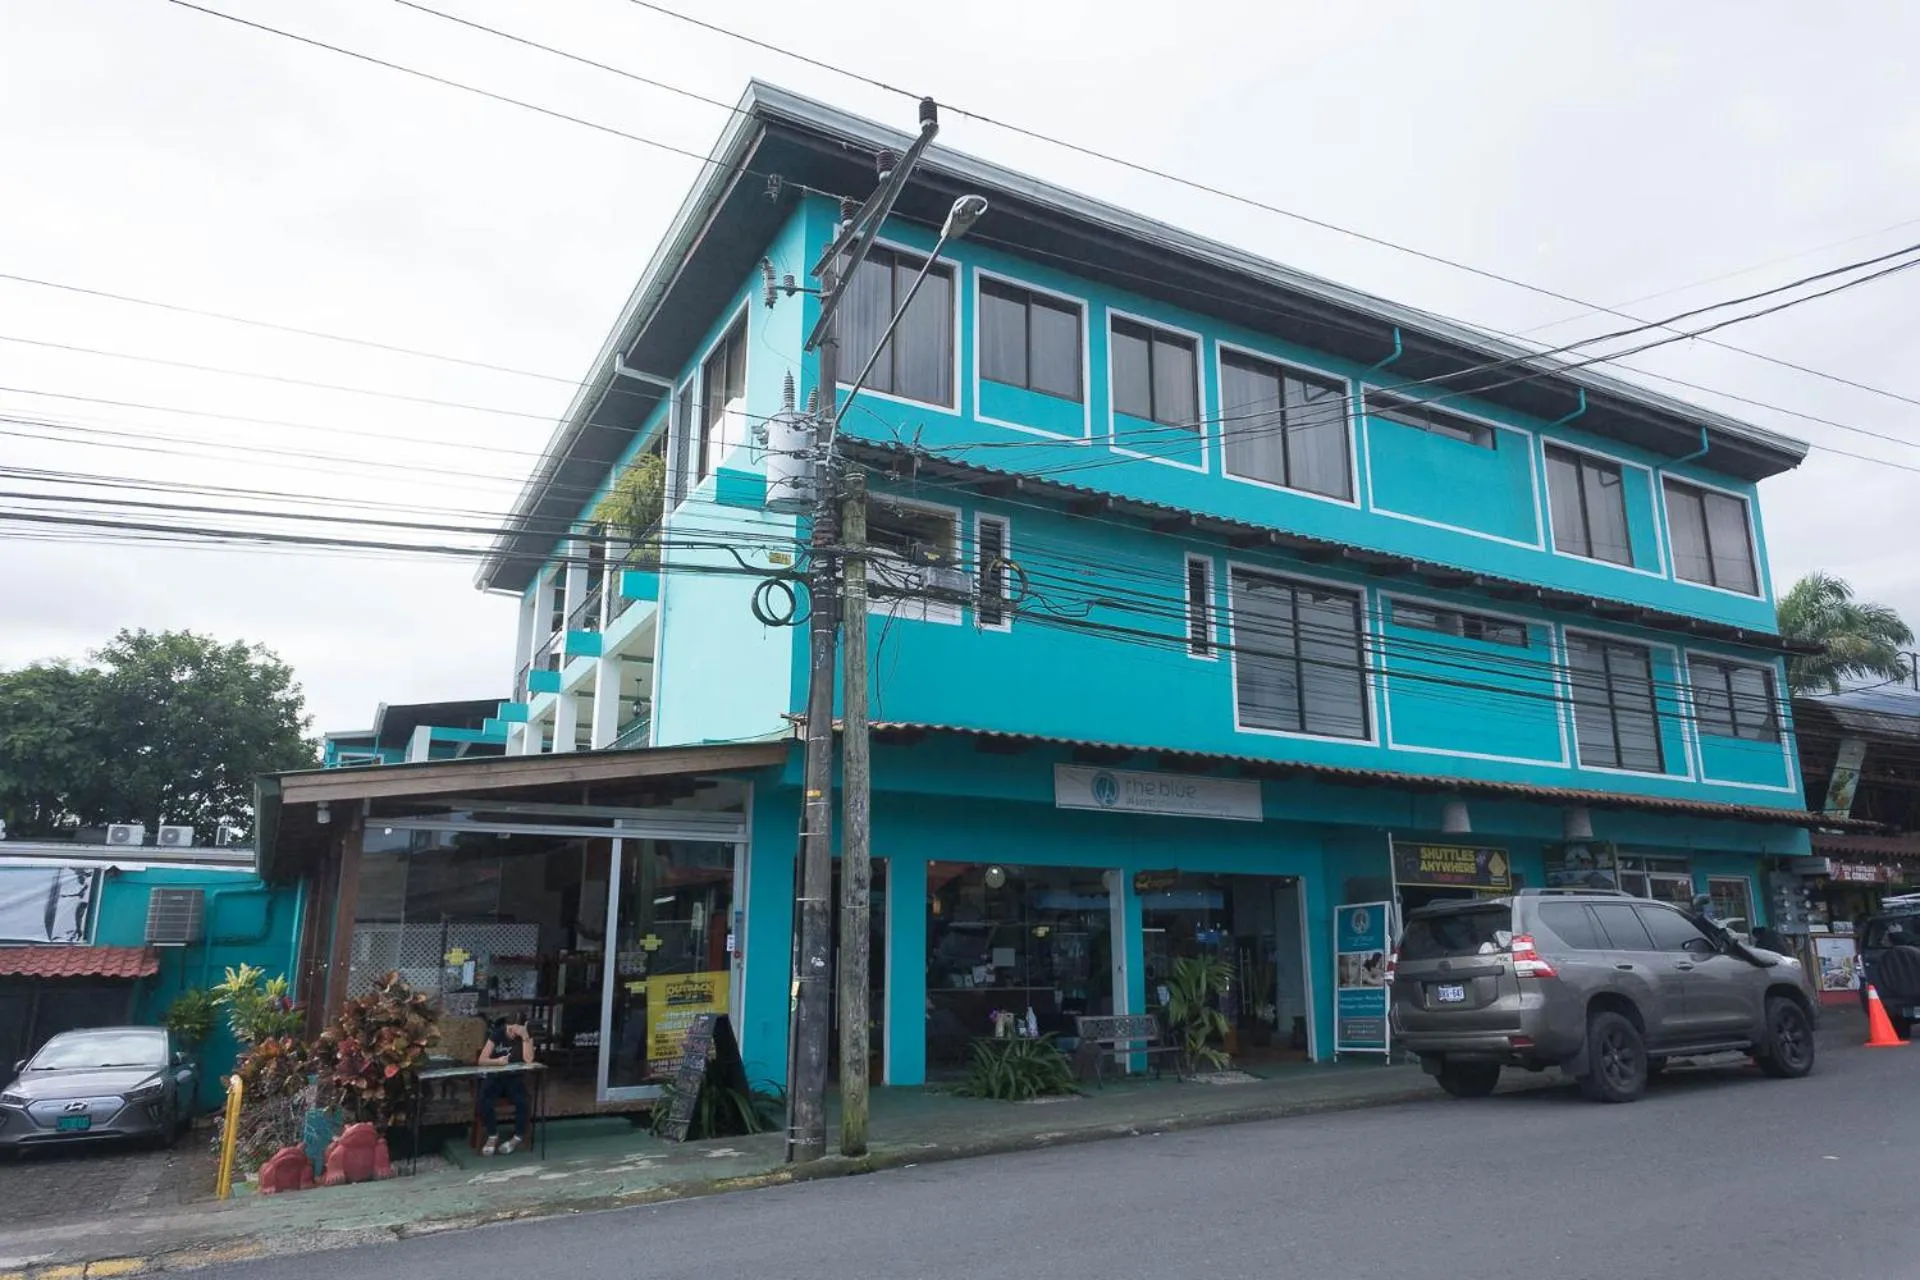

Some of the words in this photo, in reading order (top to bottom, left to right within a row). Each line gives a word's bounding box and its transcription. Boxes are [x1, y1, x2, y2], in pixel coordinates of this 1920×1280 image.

[1159, 778, 1197, 799] blue
[1420, 847, 1475, 861] SHUTTLES
[1420, 859, 1477, 873] ANYWHERE
[666, 982, 714, 995] OUTBACK
